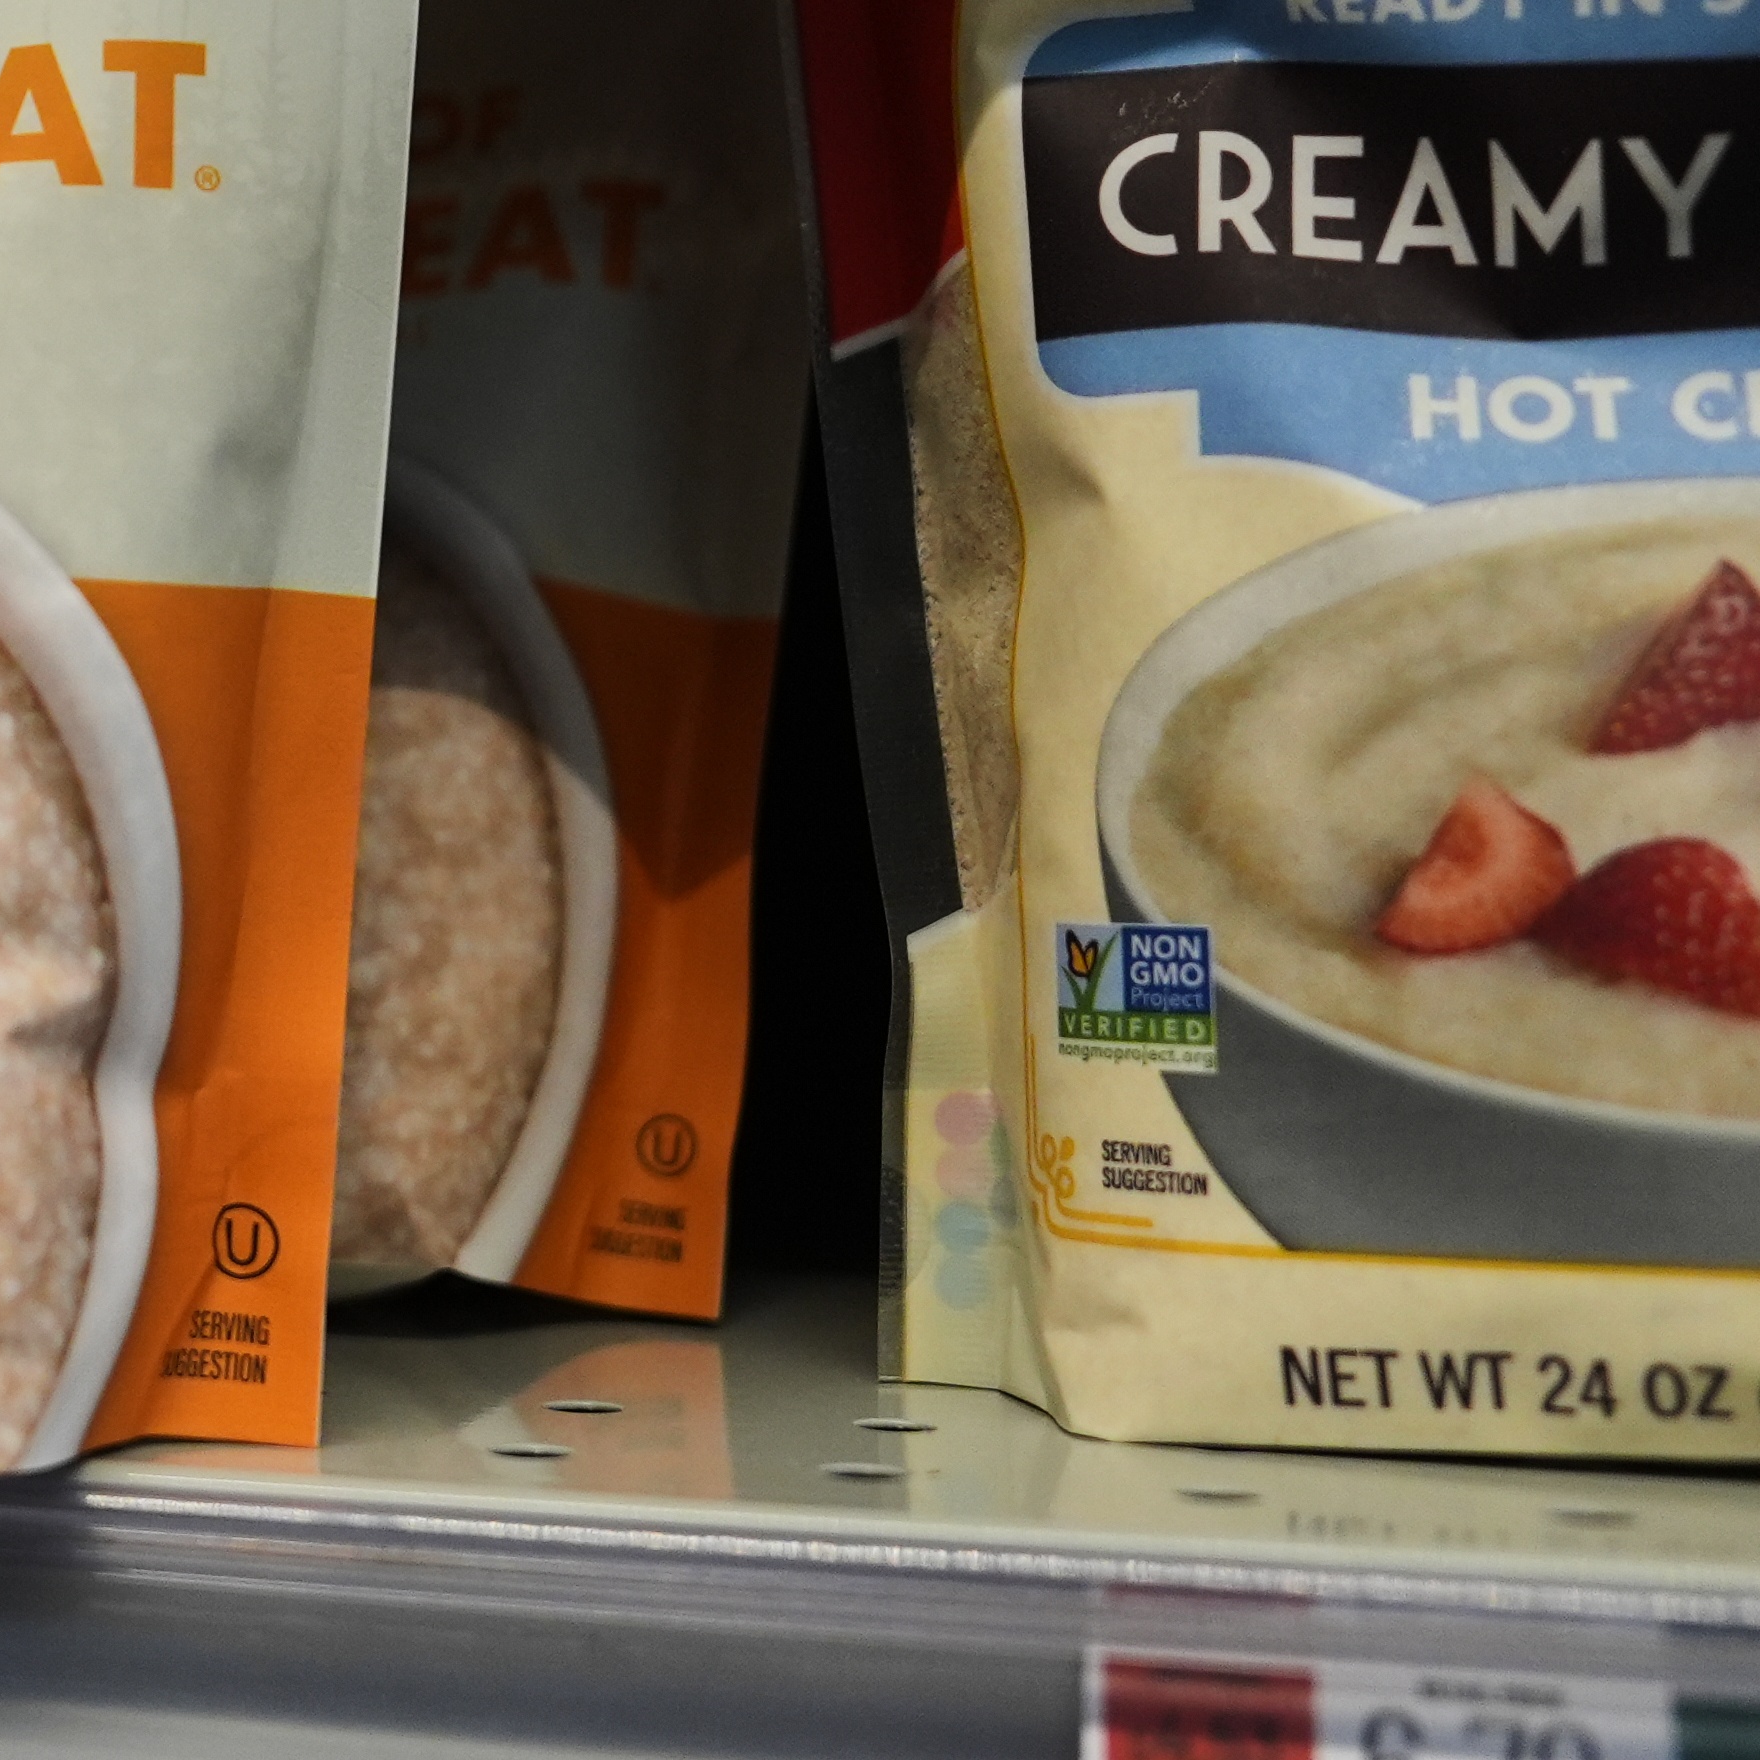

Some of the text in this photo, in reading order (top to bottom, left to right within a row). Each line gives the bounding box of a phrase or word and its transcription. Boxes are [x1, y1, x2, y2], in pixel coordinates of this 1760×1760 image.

[1097, 130, 1736, 270] CREAMY
[1408, 371, 1630, 443] HOT
[1130, 933, 1202, 960] NON
[1130, 960, 1205, 988] GMO
[1130, 987, 1205, 1012] Project
[1063, 1013, 1208, 1041] VERIFIED
[1058, 1043, 1216, 1069] nongmoproject.org
[1101, 1138, 1172, 1167] SERVING
[1101, 1167, 1209, 1197] SUGGESTION
[188, 1309, 270, 1346] SERVING
[1280, 1345, 1736, 1421] NET WT 24 OZ
